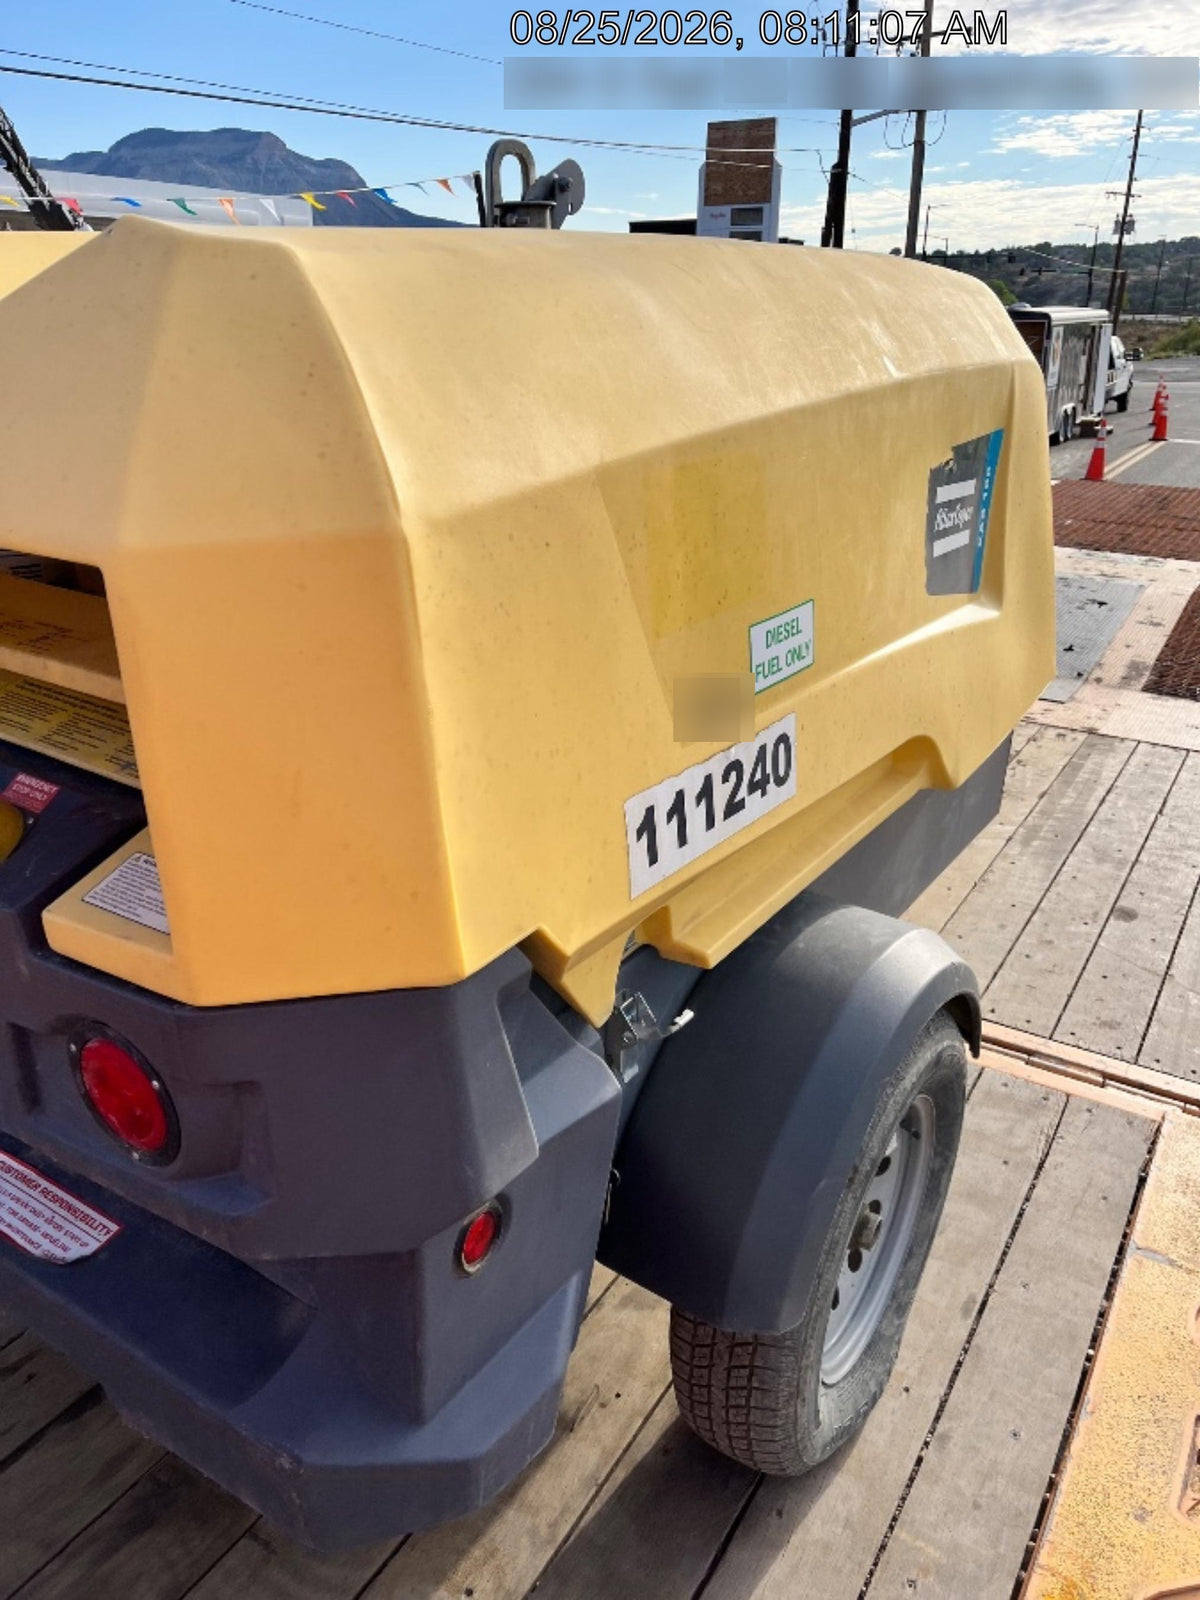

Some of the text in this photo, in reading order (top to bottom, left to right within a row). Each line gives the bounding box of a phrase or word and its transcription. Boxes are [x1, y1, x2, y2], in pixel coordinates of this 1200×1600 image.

[766, 616, 802, 649] DIESEL
[755, 638, 812, 683] FUEL ONLY
[636, 731, 793, 868] 111240
[40, 1186, 114, 1237] RESPONSIBILITY
